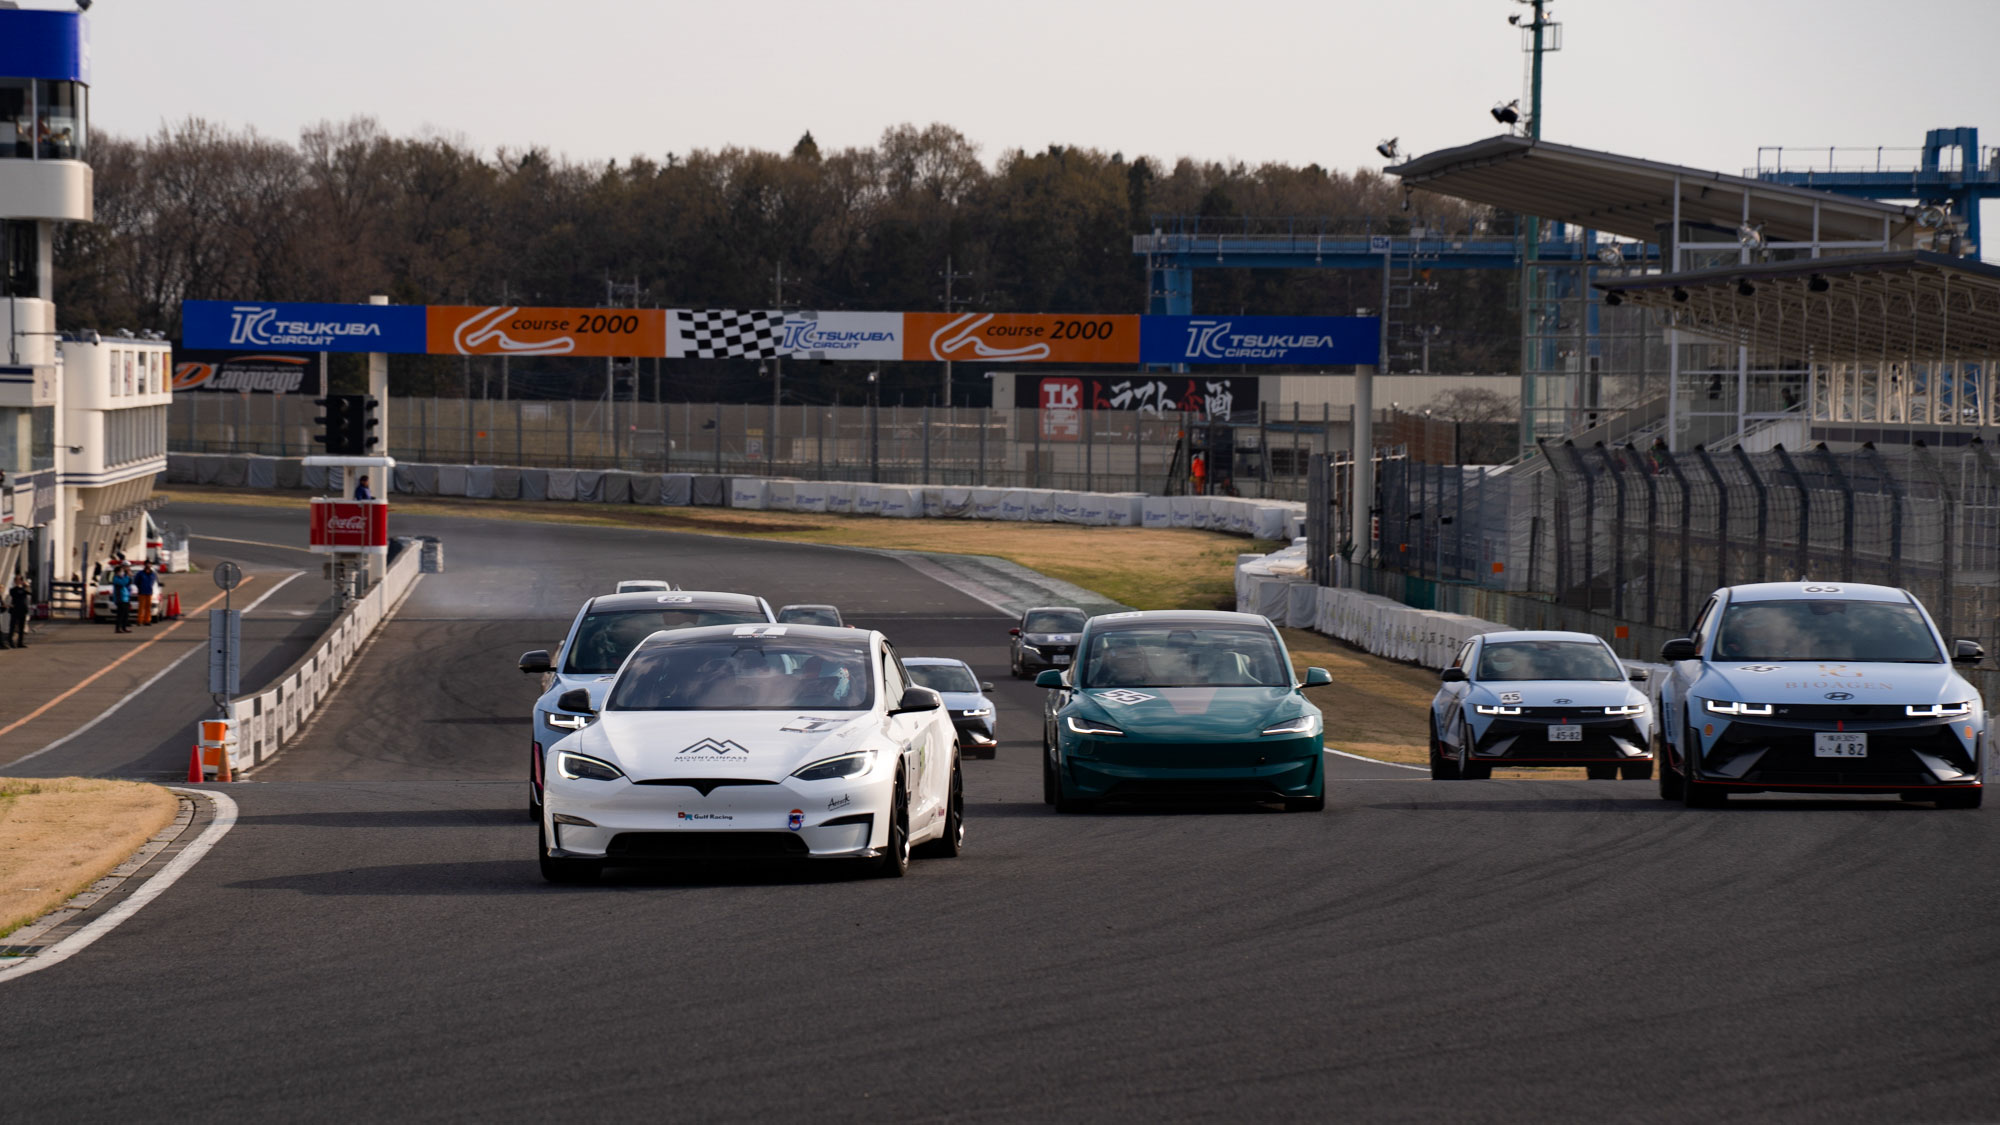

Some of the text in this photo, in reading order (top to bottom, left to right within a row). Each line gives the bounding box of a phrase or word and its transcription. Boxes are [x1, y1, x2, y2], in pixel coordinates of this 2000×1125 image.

[275, 321, 381, 336] TSUKUBA
[511, 314, 639, 334] course 2000
[986, 320, 1113, 340] course 2000
[816, 331, 895, 342] TSUKUBA
[1230, 335, 1334, 348] TSUKUBA
[328, 515, 368, 529] Coca-Cola
[1785, 681, 1894, 690] BIOAGEN
[1502, 693, 1520, 701] 45
